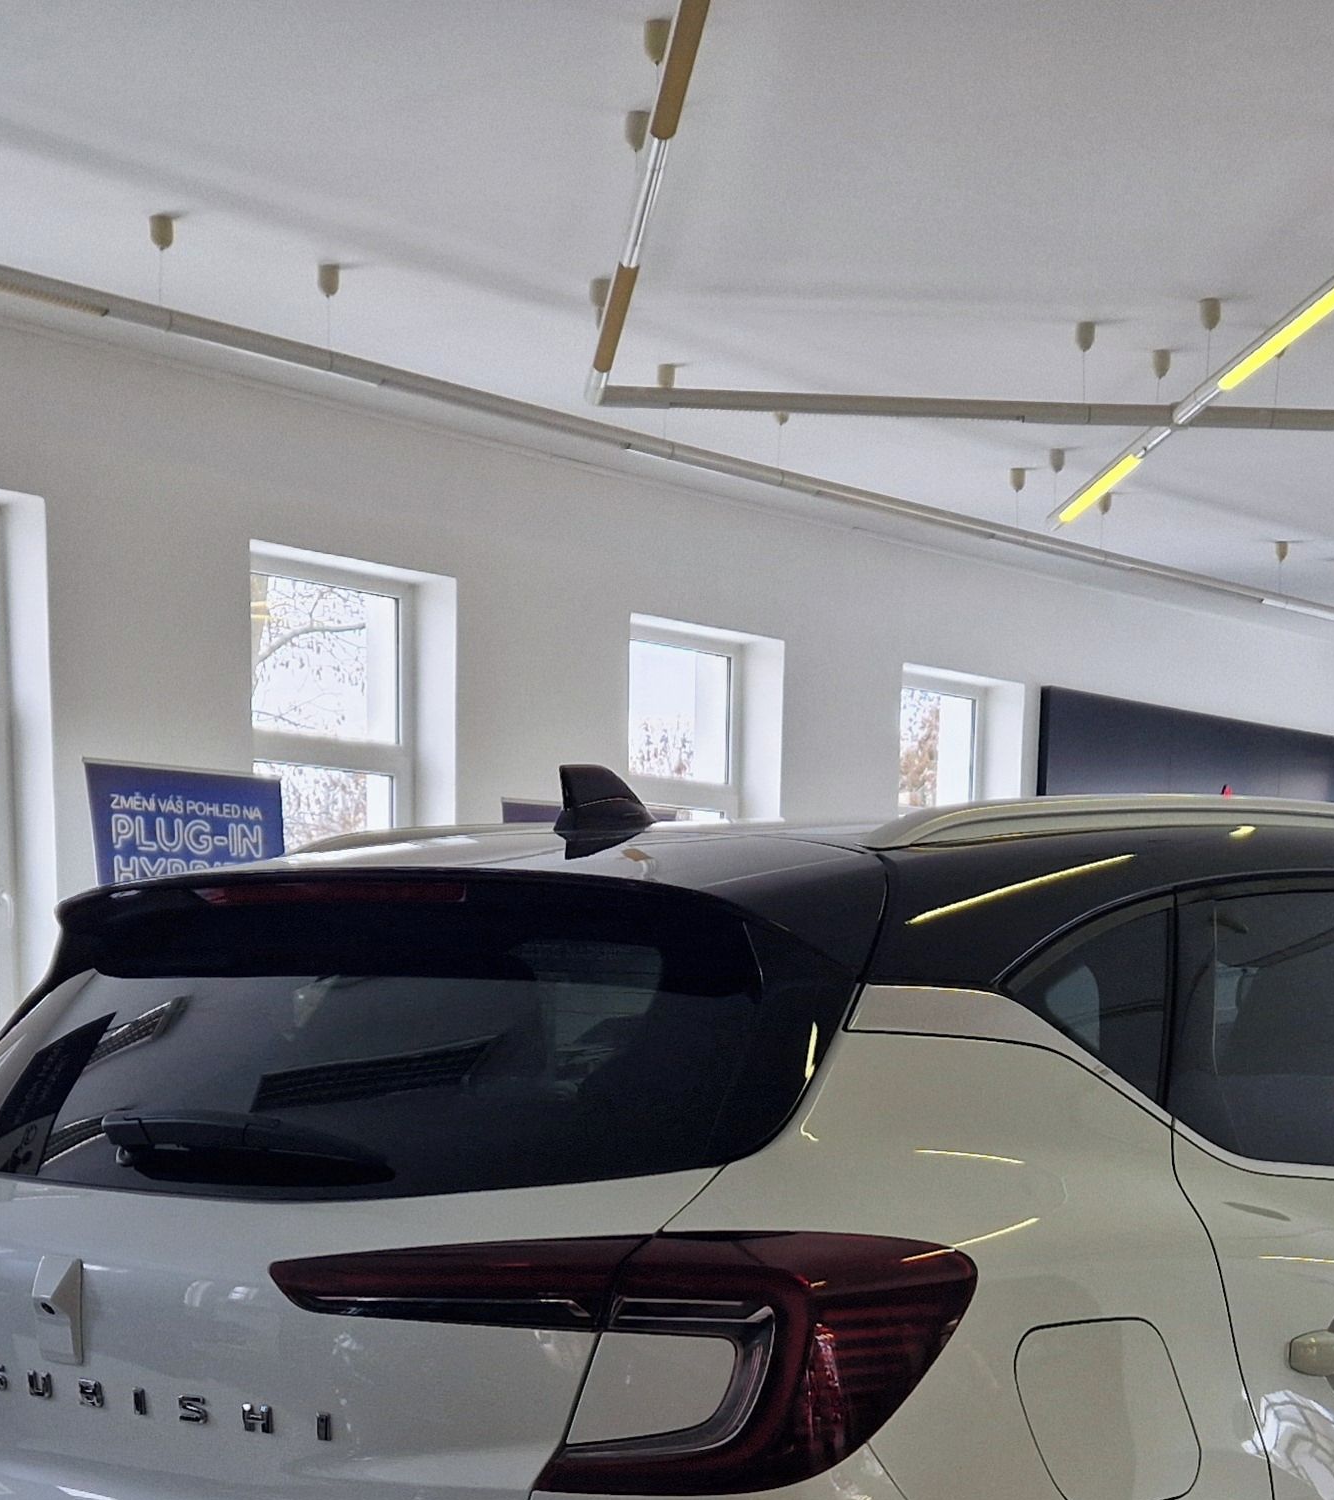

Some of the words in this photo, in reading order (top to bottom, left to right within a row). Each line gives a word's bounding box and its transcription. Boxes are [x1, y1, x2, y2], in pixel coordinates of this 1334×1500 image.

[110, 792, 156, 812] ZMĚNÍ
[157, 795, 184, 814] VÁŠ
[186, 800, 241, 819] POHLED
[243, 804, 263, 821] NA
[111, 814, 263, 858] PLUG-IN
